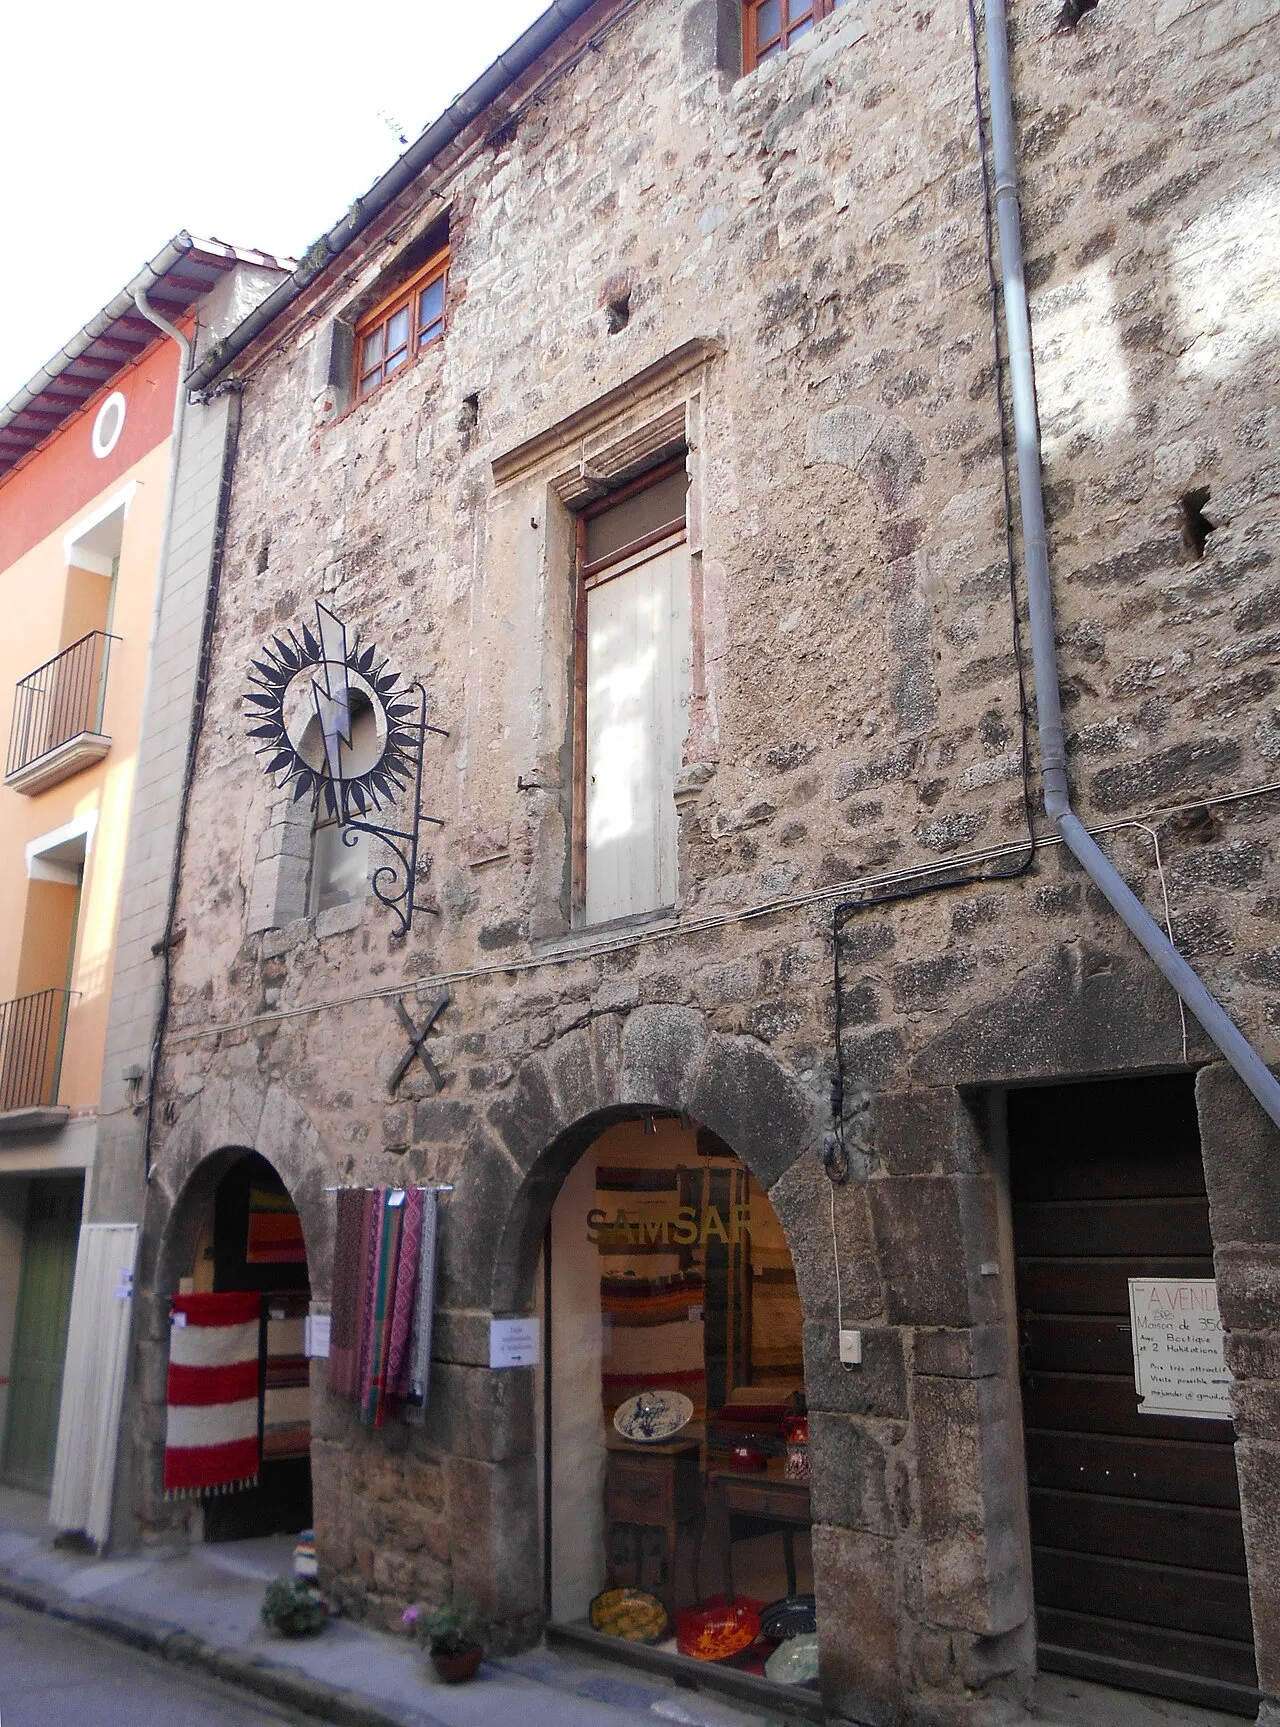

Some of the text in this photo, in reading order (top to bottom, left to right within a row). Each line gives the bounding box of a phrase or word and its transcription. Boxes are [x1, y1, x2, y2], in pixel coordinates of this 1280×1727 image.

[1148, 1287, 1163, 1309] A
[1137, 1316, 1173, 1330] Maison
[1179, 1318, 1191, 1331] de
[1166, 1333, 1210, 1344] Boutique
[1152, 1343, 1159, 1352] 2
[1166, 1343, 1218, 1355] Habitations
[1190, 1366, 1227, 1374] attractif
[1151, 1375, 1207, 1385] Visite possible
